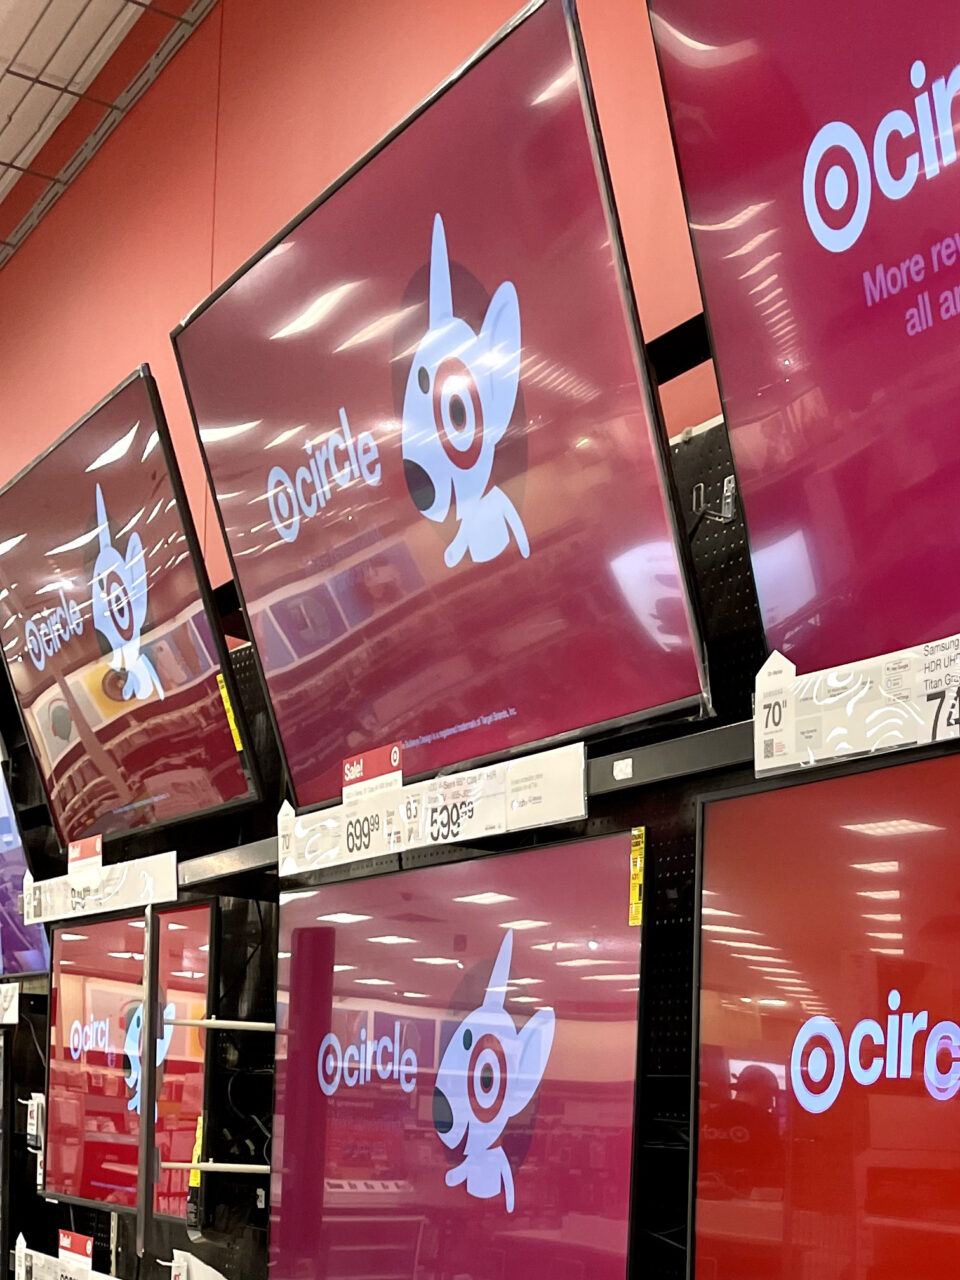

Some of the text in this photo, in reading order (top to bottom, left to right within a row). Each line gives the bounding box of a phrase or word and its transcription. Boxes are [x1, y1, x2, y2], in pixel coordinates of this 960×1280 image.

[863, 254, 925, 307] More
[905, 295, 932, 336] all
[298, 407, 381, 518] circle
[923, 636, 960, 657] Samsung
[924, 657, 941, 674] HDR
[345, 759, 363, 782] Sale!
[343, 1021, 418, 1092] circle
